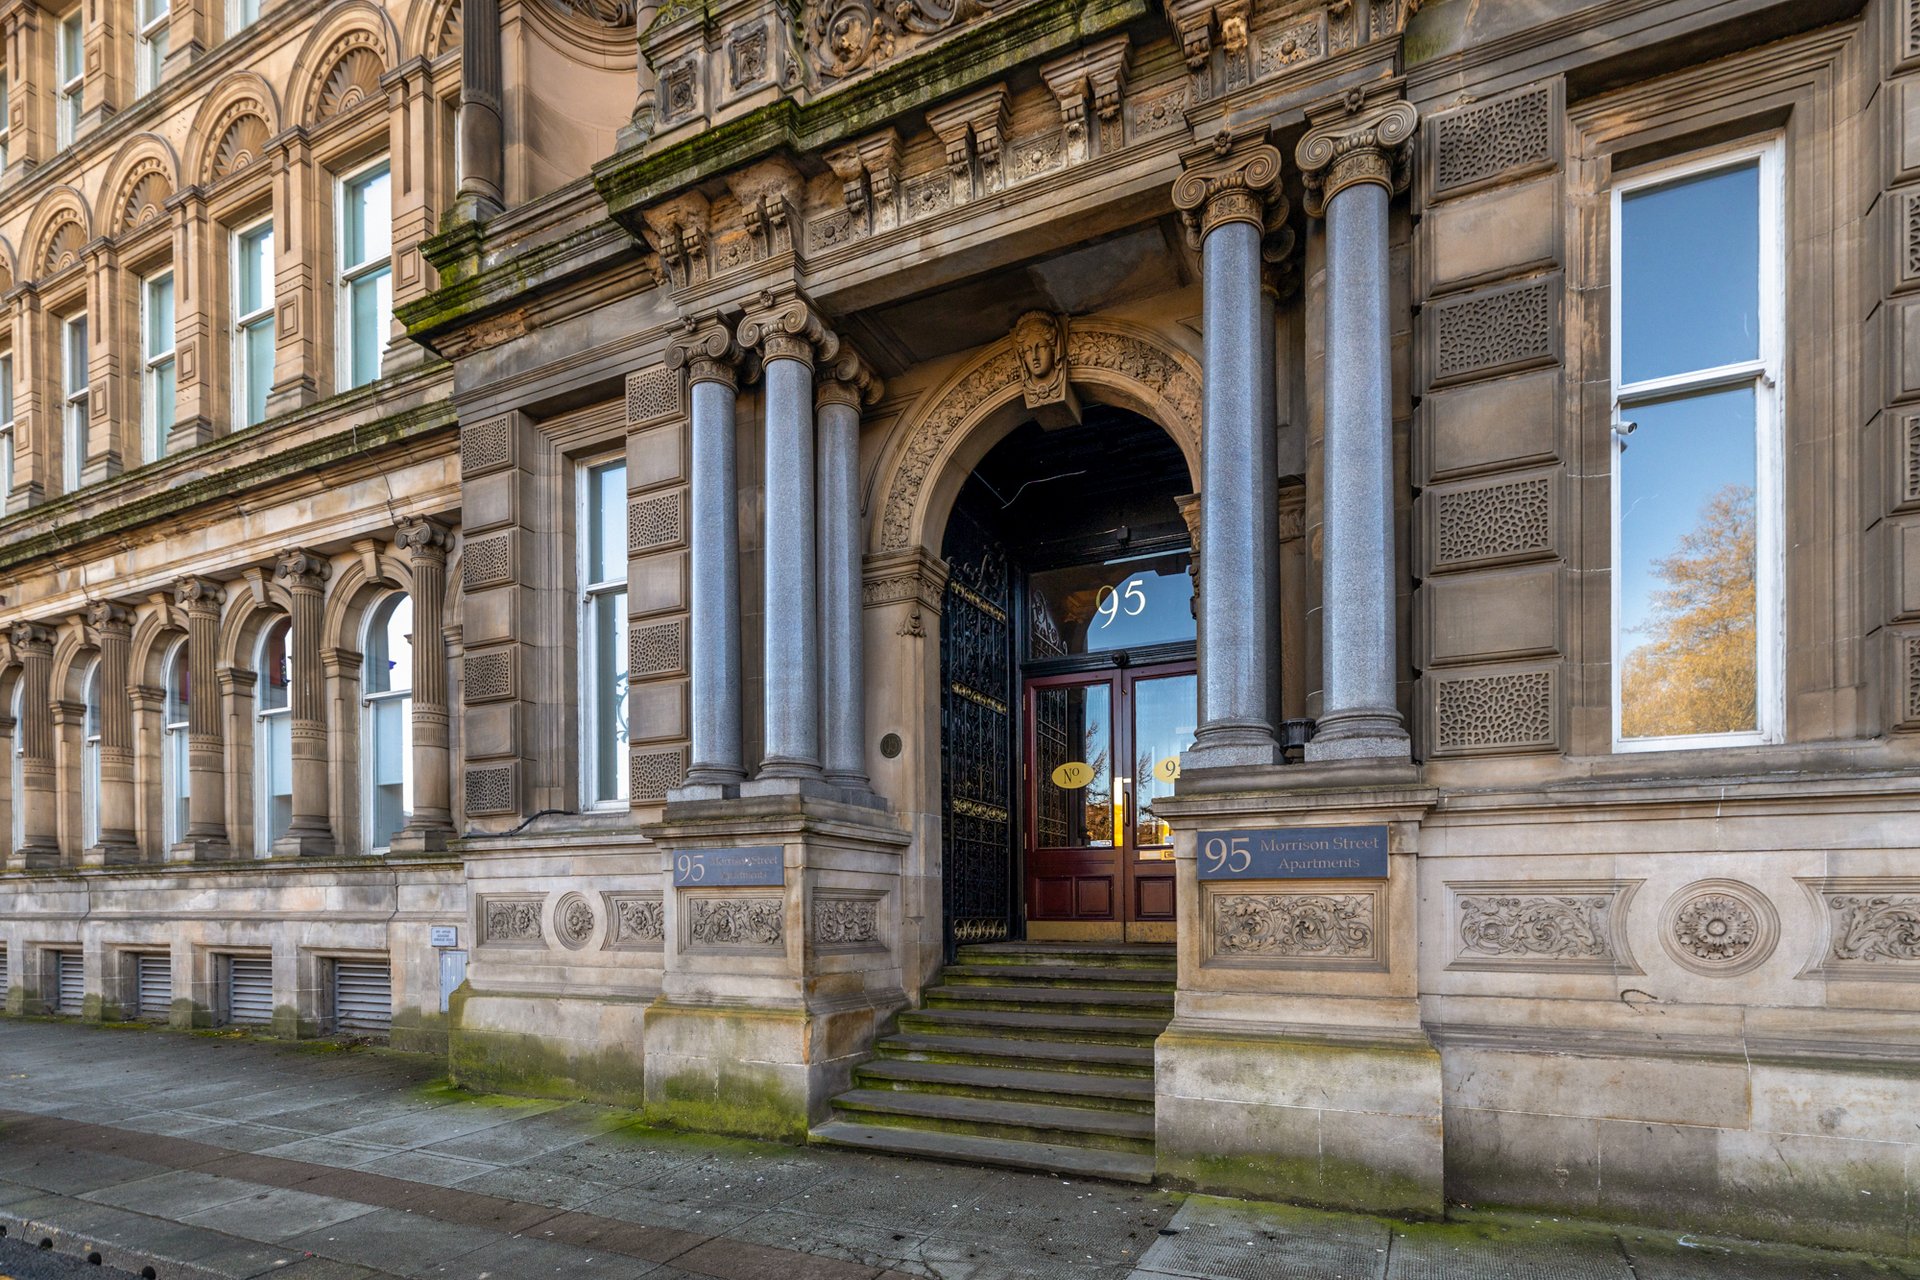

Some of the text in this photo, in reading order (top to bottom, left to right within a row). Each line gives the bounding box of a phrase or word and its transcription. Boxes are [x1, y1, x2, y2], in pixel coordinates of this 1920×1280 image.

[1095, 579, 1146, 629] 95
[1165, 760, 1180, 778] 9
[677, 854, 705, 882] 95
[751, 855, 778, 865] Street
[1204, 836, 1379, 873] 95 Morrison Street
[1278, 857, 1360, 873] Apartments
